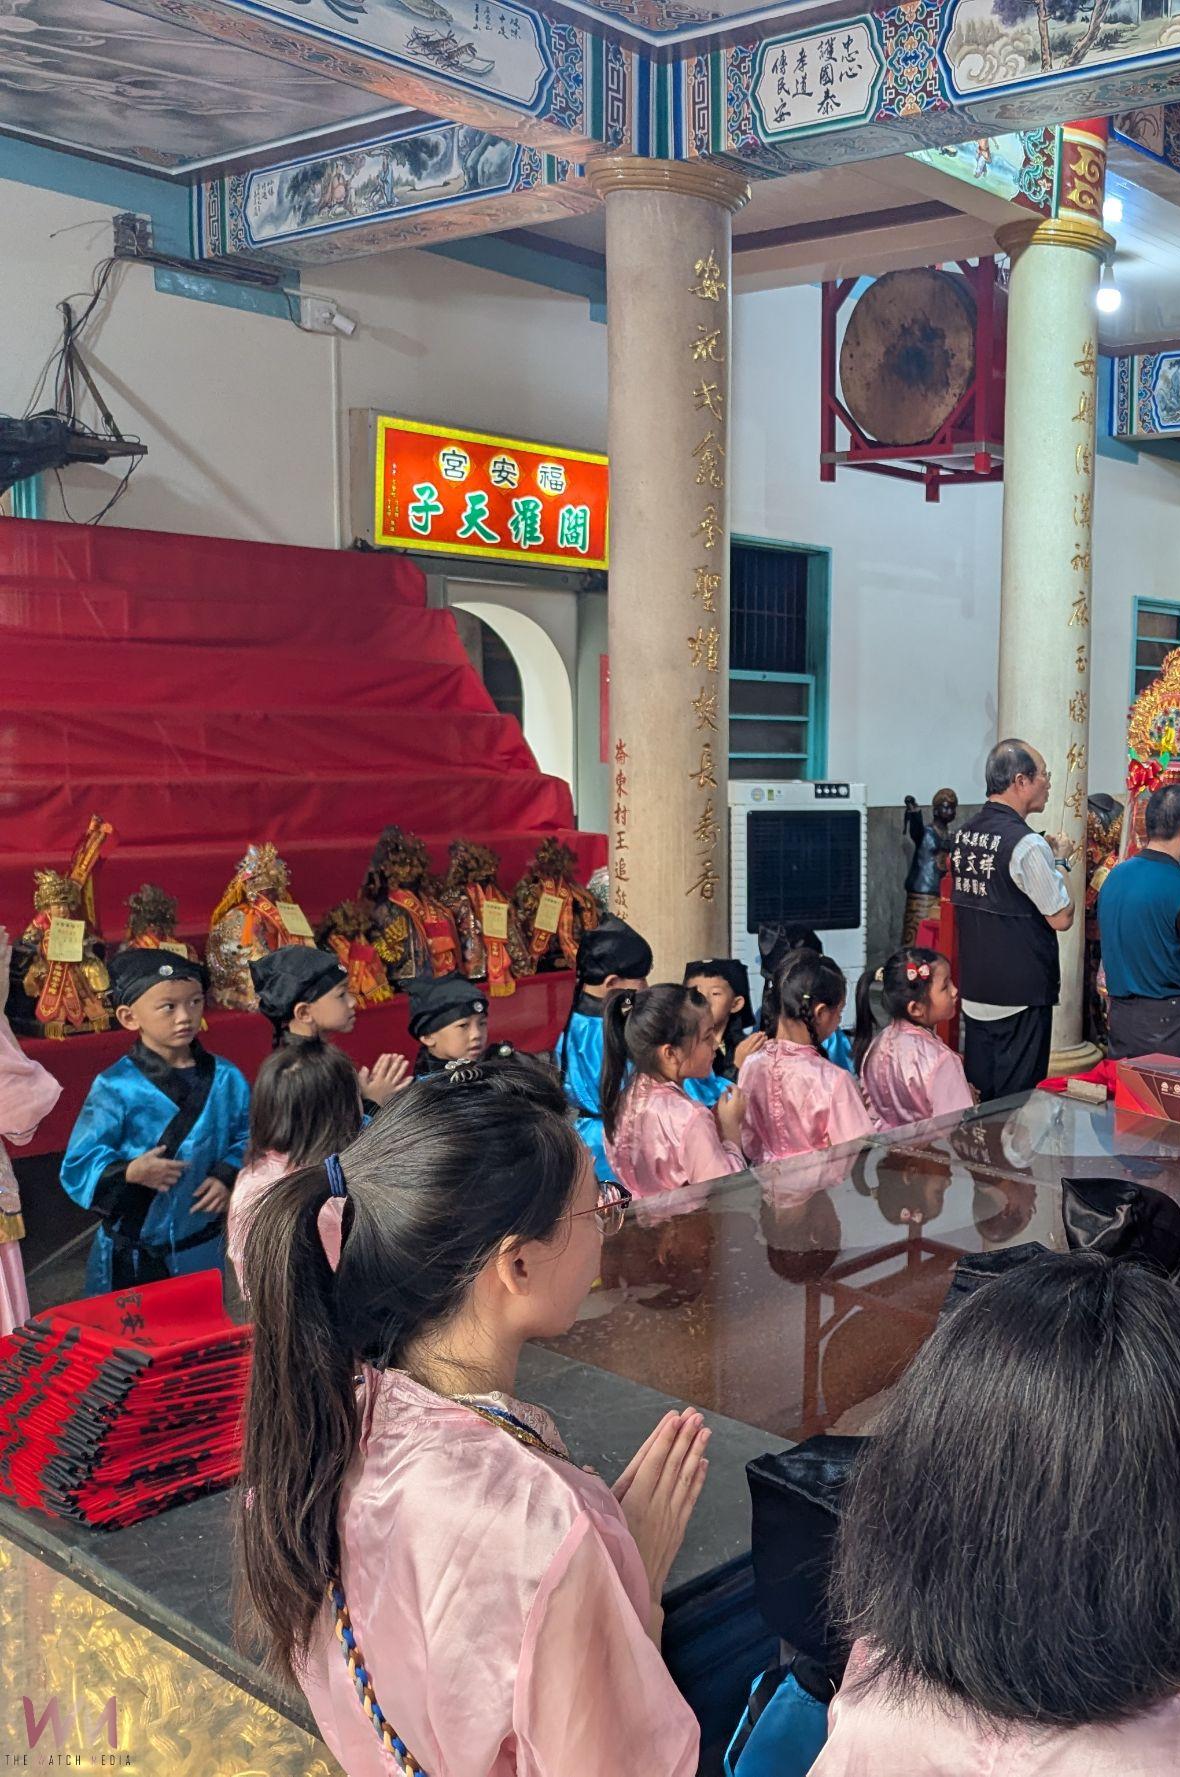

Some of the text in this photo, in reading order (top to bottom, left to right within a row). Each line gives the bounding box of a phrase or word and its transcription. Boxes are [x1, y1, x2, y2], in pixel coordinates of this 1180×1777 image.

[441, 449, 566, 492] 福安宮
[408, 484, 590, 551] 閻羅天子
